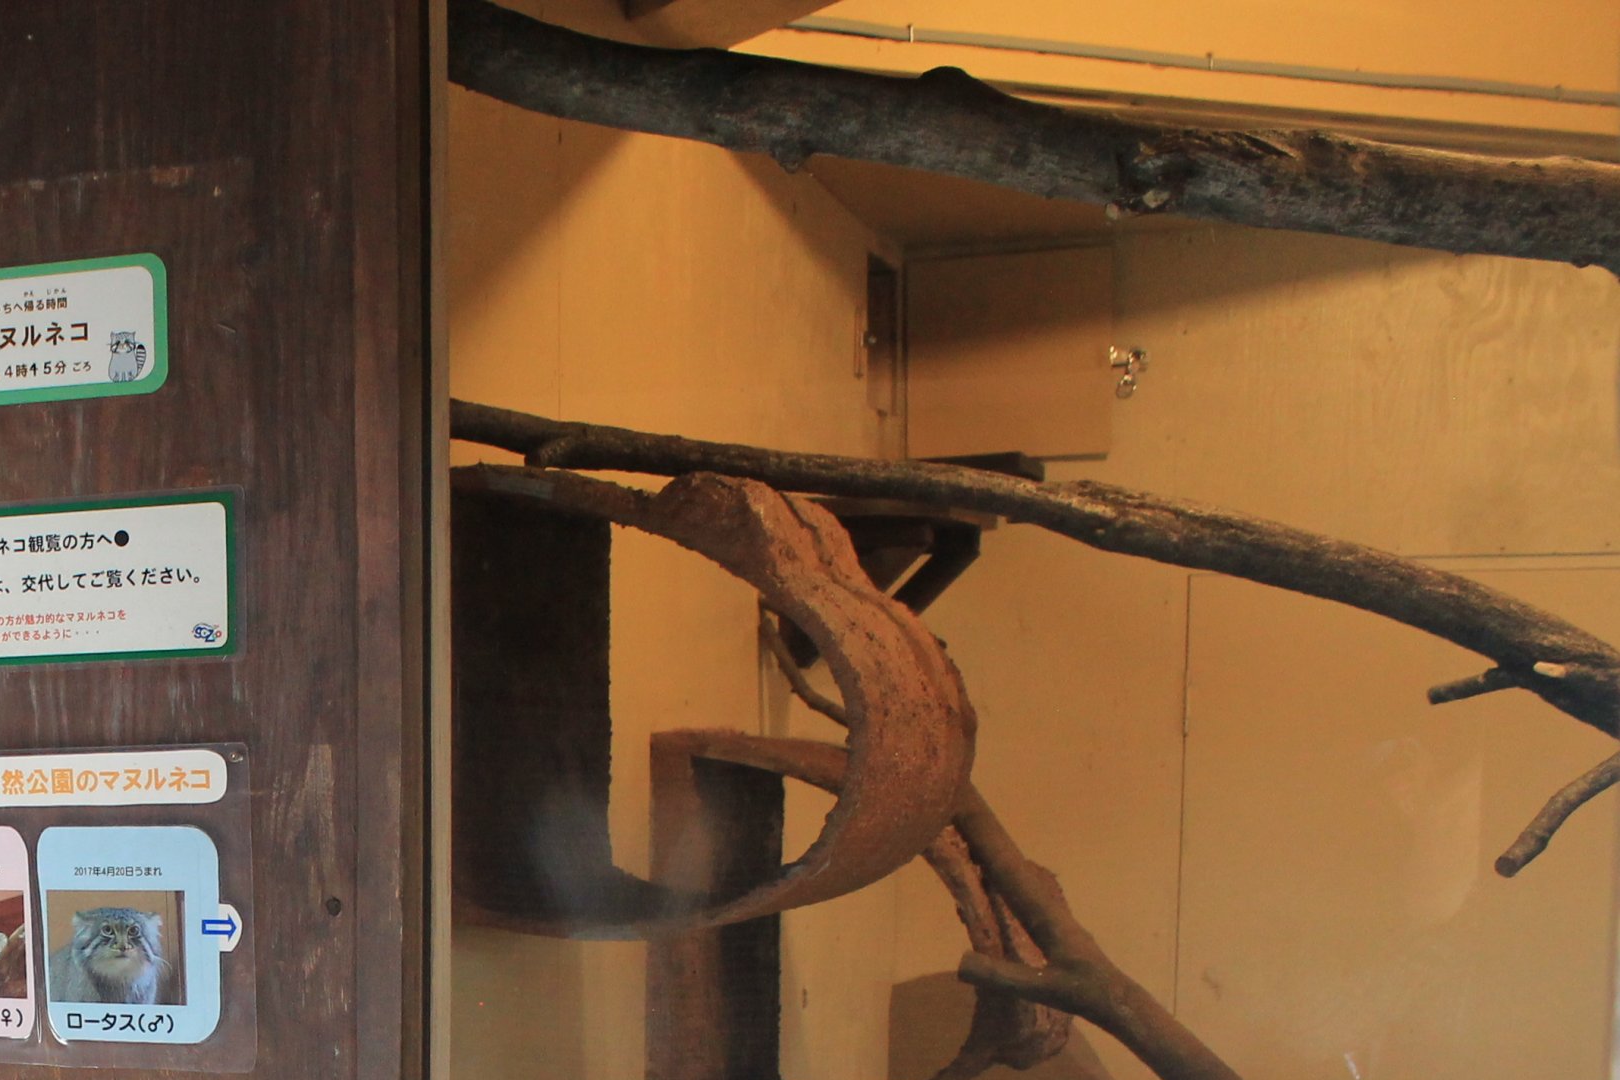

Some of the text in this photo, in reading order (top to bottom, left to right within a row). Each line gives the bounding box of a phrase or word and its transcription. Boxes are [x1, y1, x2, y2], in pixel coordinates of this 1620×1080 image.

[74, 866, 162, 877] 2017年4月20日うまれ
